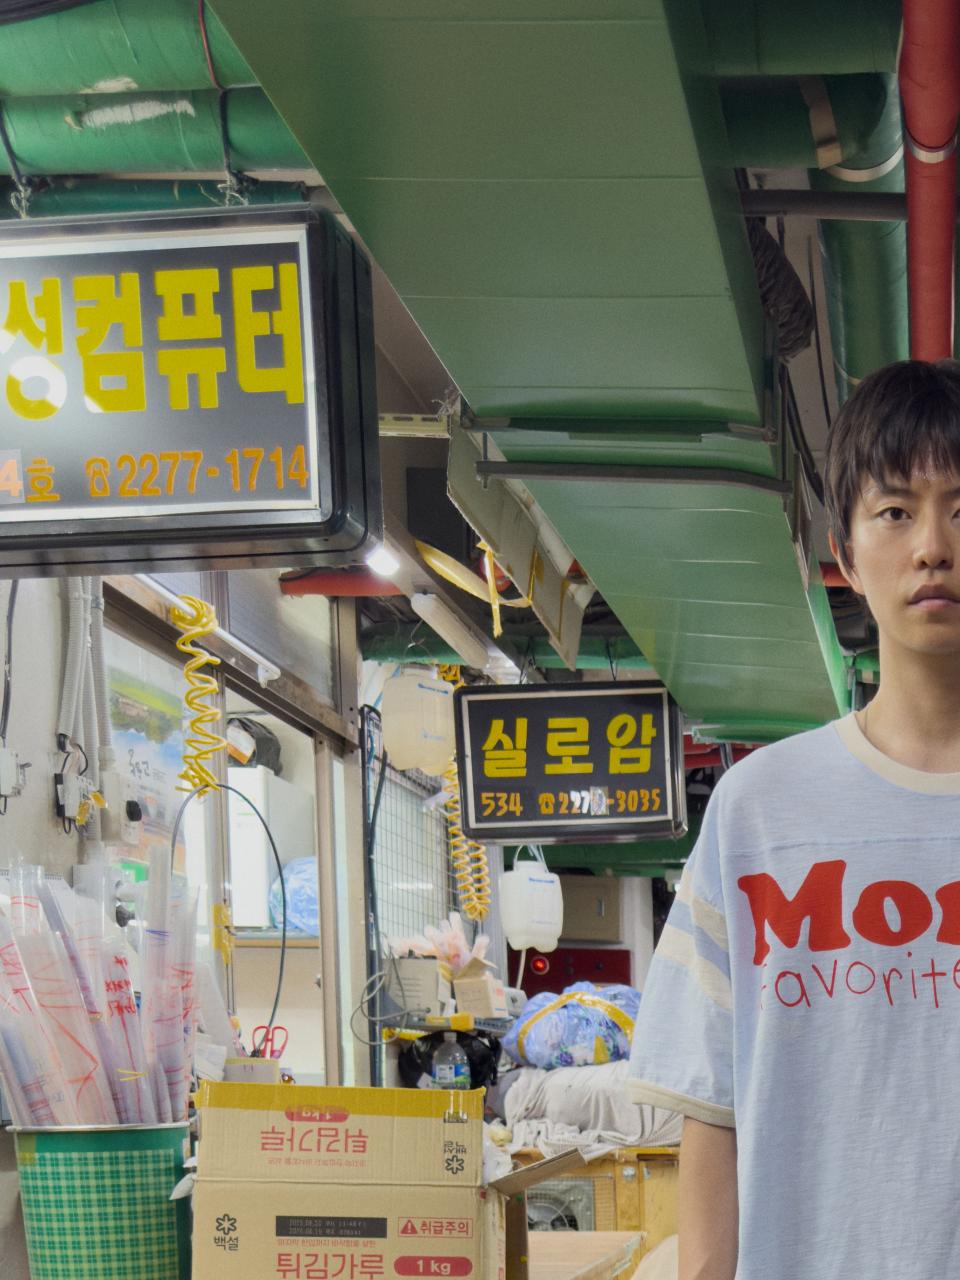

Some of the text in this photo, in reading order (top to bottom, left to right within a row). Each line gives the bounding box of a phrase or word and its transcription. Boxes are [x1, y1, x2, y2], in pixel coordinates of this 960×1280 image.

[117, 444, 309, 497] 2277-1714
[481, 713, 656, 778] 실로암
[481, 791, 523, 817] 534
[260, 1125, 369, 1154] 튀김가루
[419, 1220, 470, 1235] 취급주의
[213, 1236, 239, 1251] 백설
[275, 1252, 385, 1280] 튀김가루
[417, 1260, 451, 1275] 1 kg
